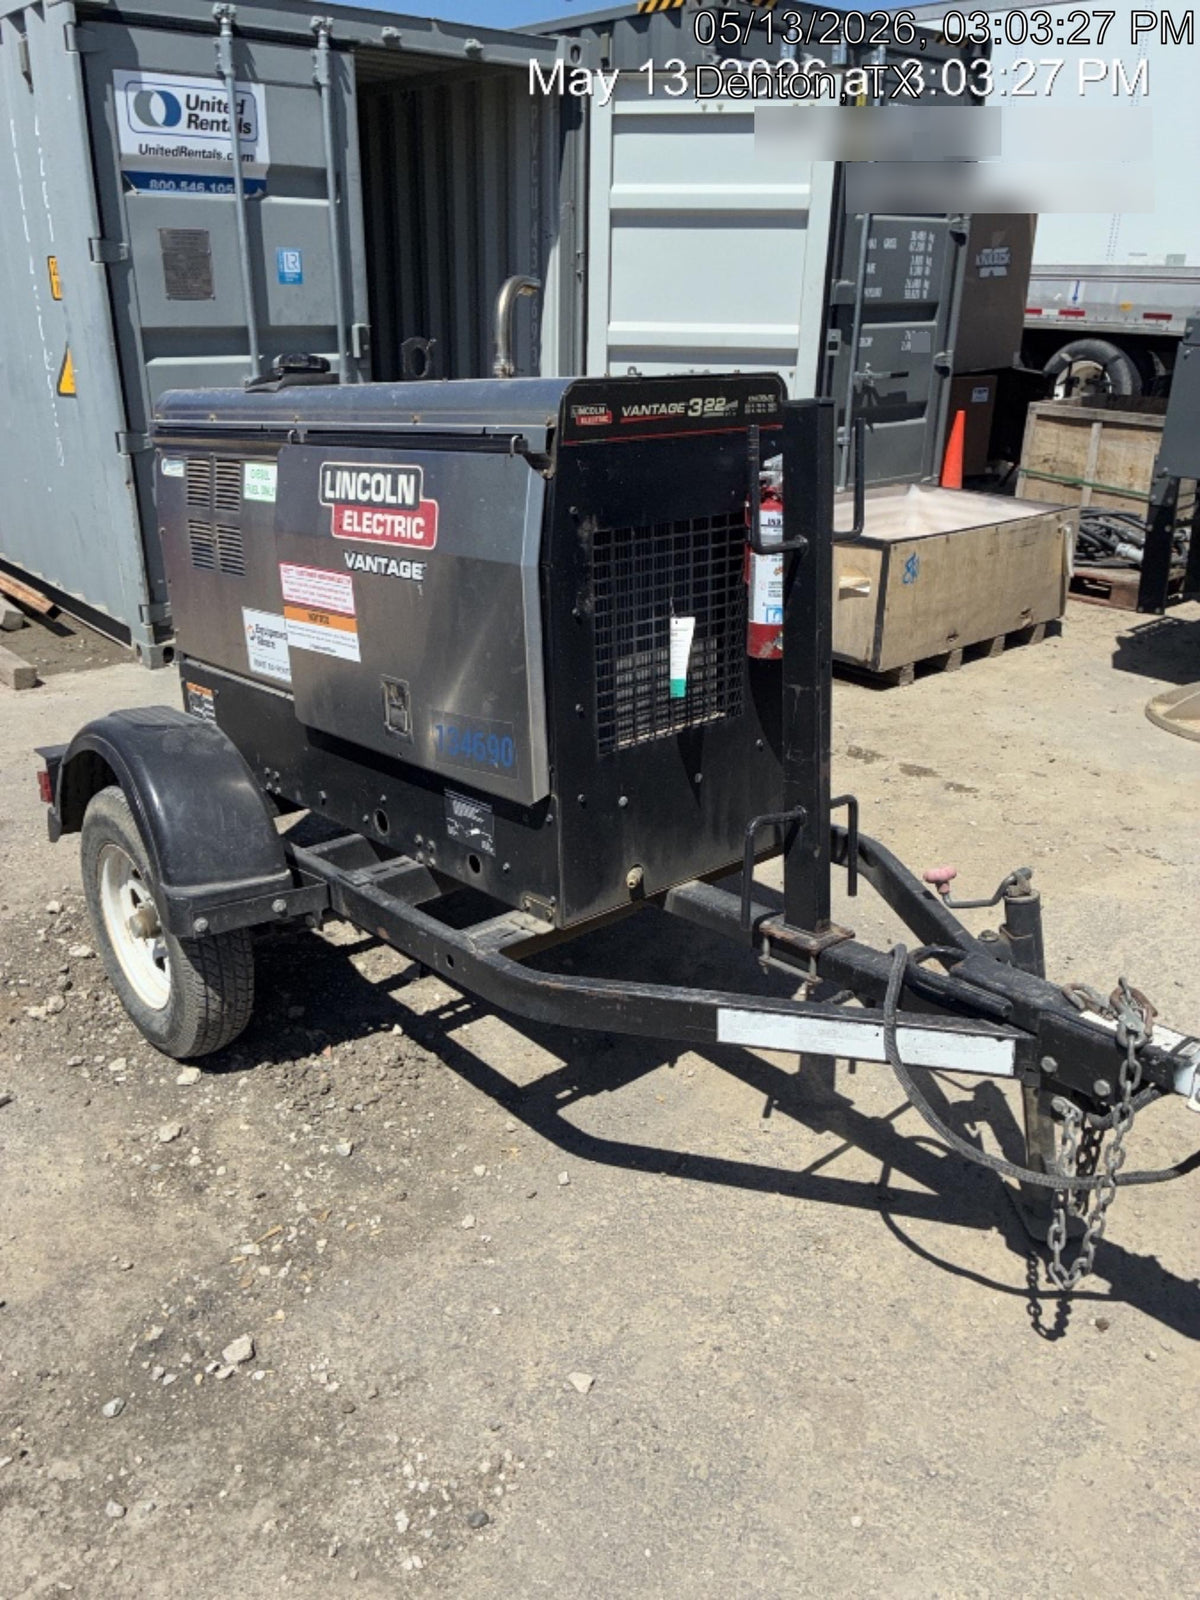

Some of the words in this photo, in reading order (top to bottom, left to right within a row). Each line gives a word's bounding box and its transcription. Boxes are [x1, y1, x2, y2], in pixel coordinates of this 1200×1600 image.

[186, 94, 246, 116] United
[187, 113, 252, 135] Rentls
[138, 143, 255, 163] UnitedRentals.cm
[149, 178, 237, 195] 800.546.105
[621, 402, 686, 417] VANTAGE
[687, 397, 726, 417] 322
[324, 470, 415, 505] LINCOLN
[342, 509, 425, 540] ELECTRIC
[344, 551, 425, 580] VANTAGE
[435, 723, 514, 770] 134690
